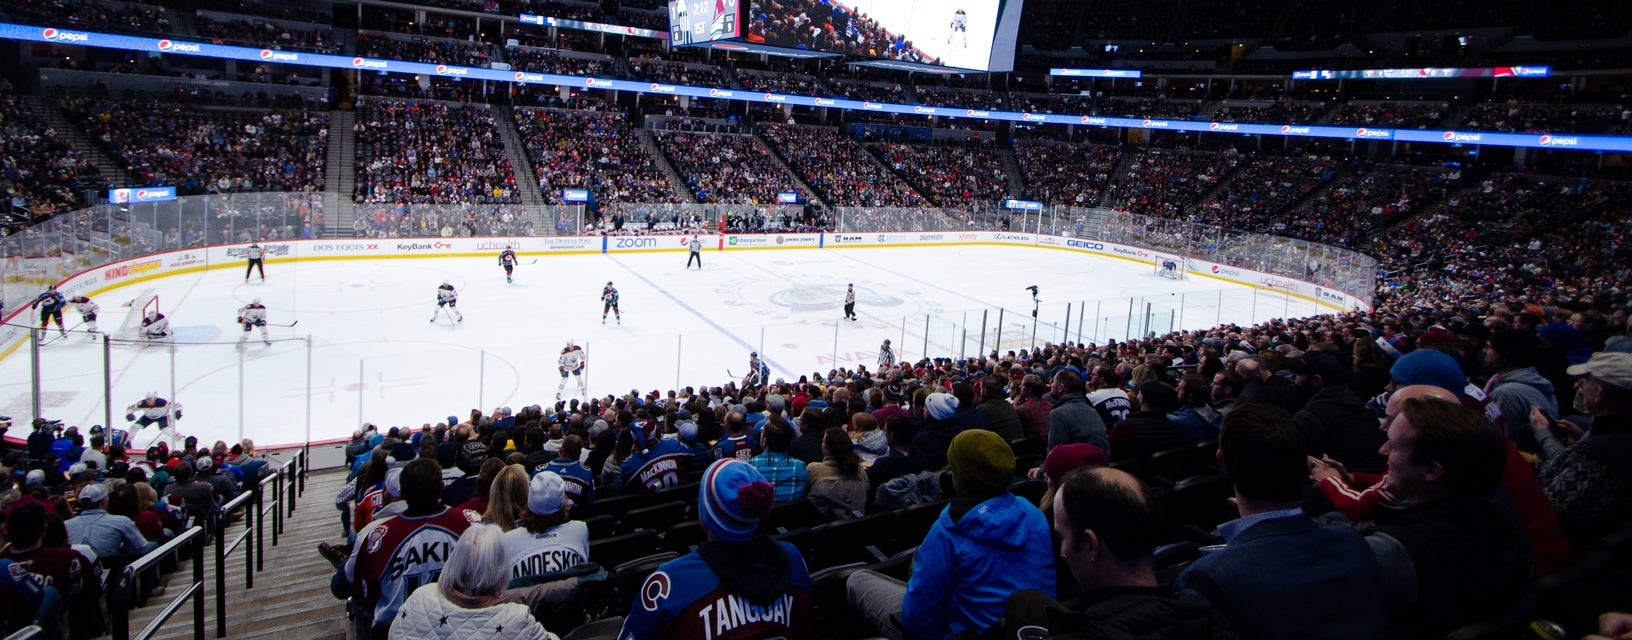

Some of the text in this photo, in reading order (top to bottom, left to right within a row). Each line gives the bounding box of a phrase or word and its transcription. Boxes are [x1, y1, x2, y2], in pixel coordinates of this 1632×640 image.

[694, 1, 709, 15] 2:12
[672, 6, 676, 20] 1
[694, 22, 705, 34] 1ST
[727, 23, 732, 32] 9
[59, 32, 88, 42] pepsi
[173, 43, 199, 51] pepsi
[274, 52, 298, 61] pepsi
[365, 60, 387, 69] pepsi
[447, 67, 467, 75] pepsi
[1367, 129, 1388, 138] pepsi
[1456, 133, 1480, 142] pepsi
[1552, 136, 1577, 146] pepsi
[149, 190, 168, 198] pepsi
[959, 233, 978, 241] xfinity
[397, 242, 432, 251] KeyBank
[476, 240, 520, 250] uchealth
[616, 237, 656, 248] zoom
[1067, 240, 1104, 250] GEICO
[336, 244, 364, 252] EQUIS
[1114, 247, 1136, 256] KeyBank
[104, 265, 128, 281] KING
[1220, 268, 1239, 277] pepsi
[1260, 276, 1298, 291] uchealth
[1323, 292, 1343, 301] RAM
[640, 460, 678, 482] MacKINNON
[535, 532, 557, 540] Reebok
[699, 594, 793, 640] TANGUAY
